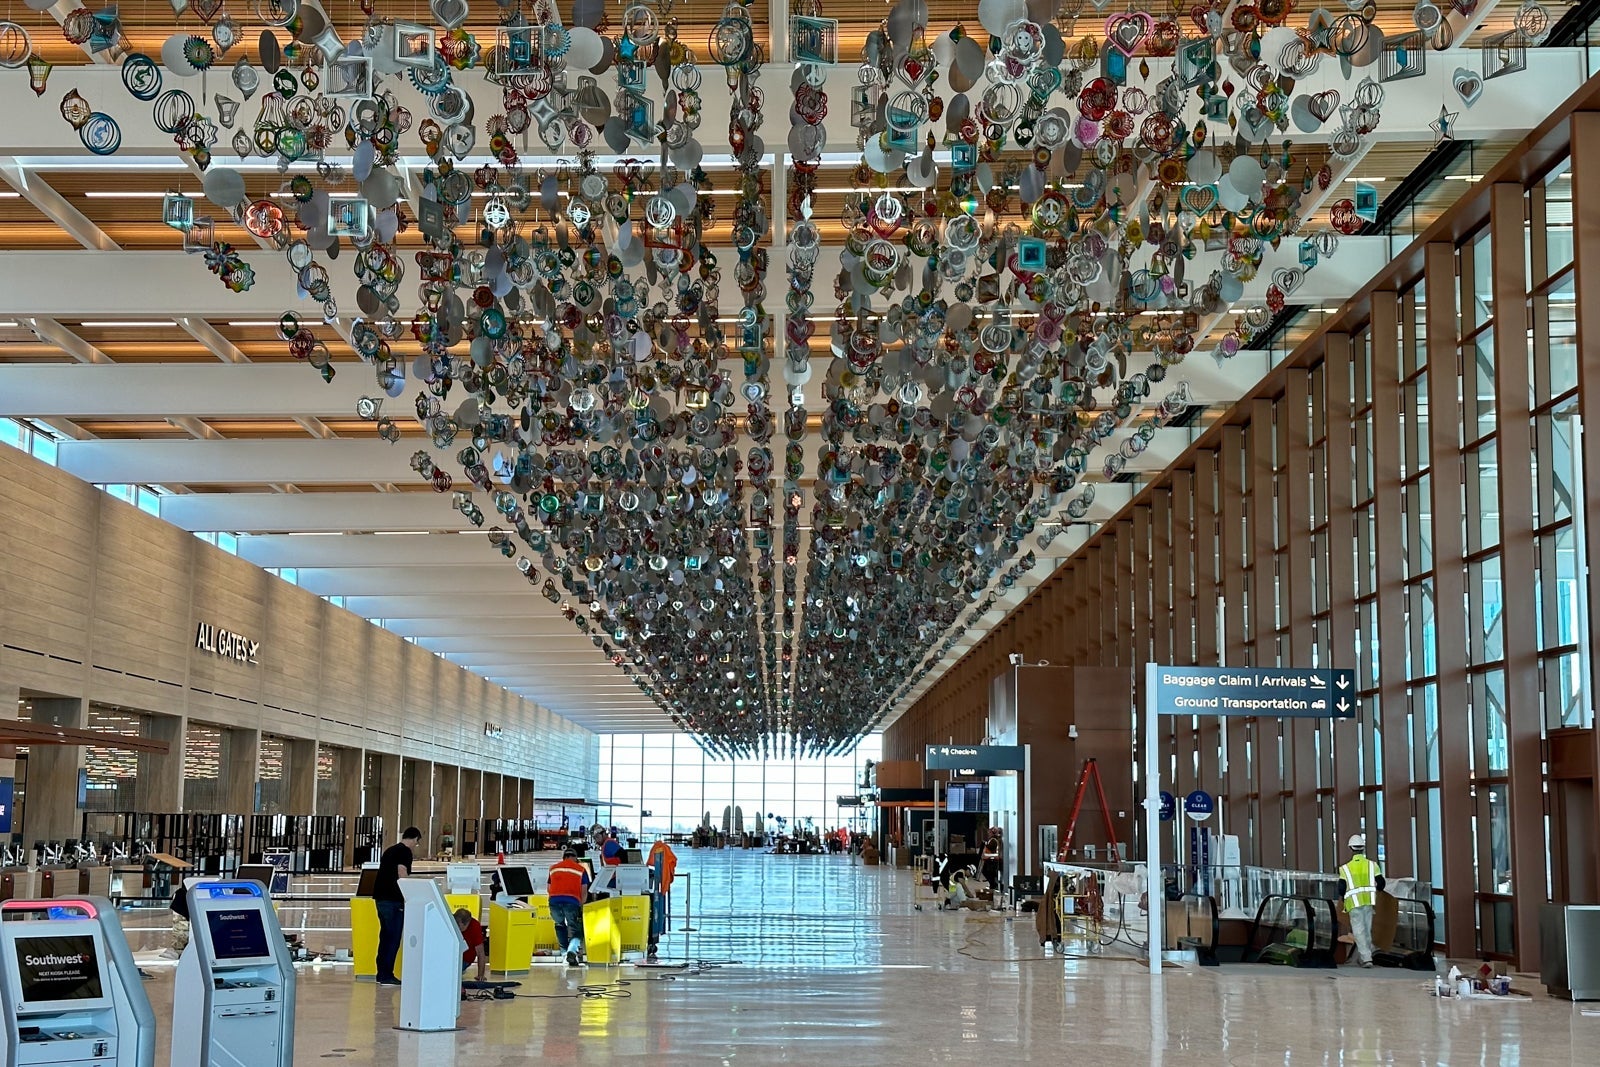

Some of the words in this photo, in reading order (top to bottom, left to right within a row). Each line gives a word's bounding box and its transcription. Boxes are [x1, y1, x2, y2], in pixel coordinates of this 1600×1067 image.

[196, 622, 217, 653] ALL
[217, 628, 247, 661] GATES
[1163, 674, 1216, 687] Baggage
[1218, 674, 1252, 686] Claim
[1262, 675, 1307, 687] Arrivals
[1174, 696, 1219, 707] Ground
[1221, 697, 1308, 710] Transportation
[25, 953, 83, 966] Southwest
